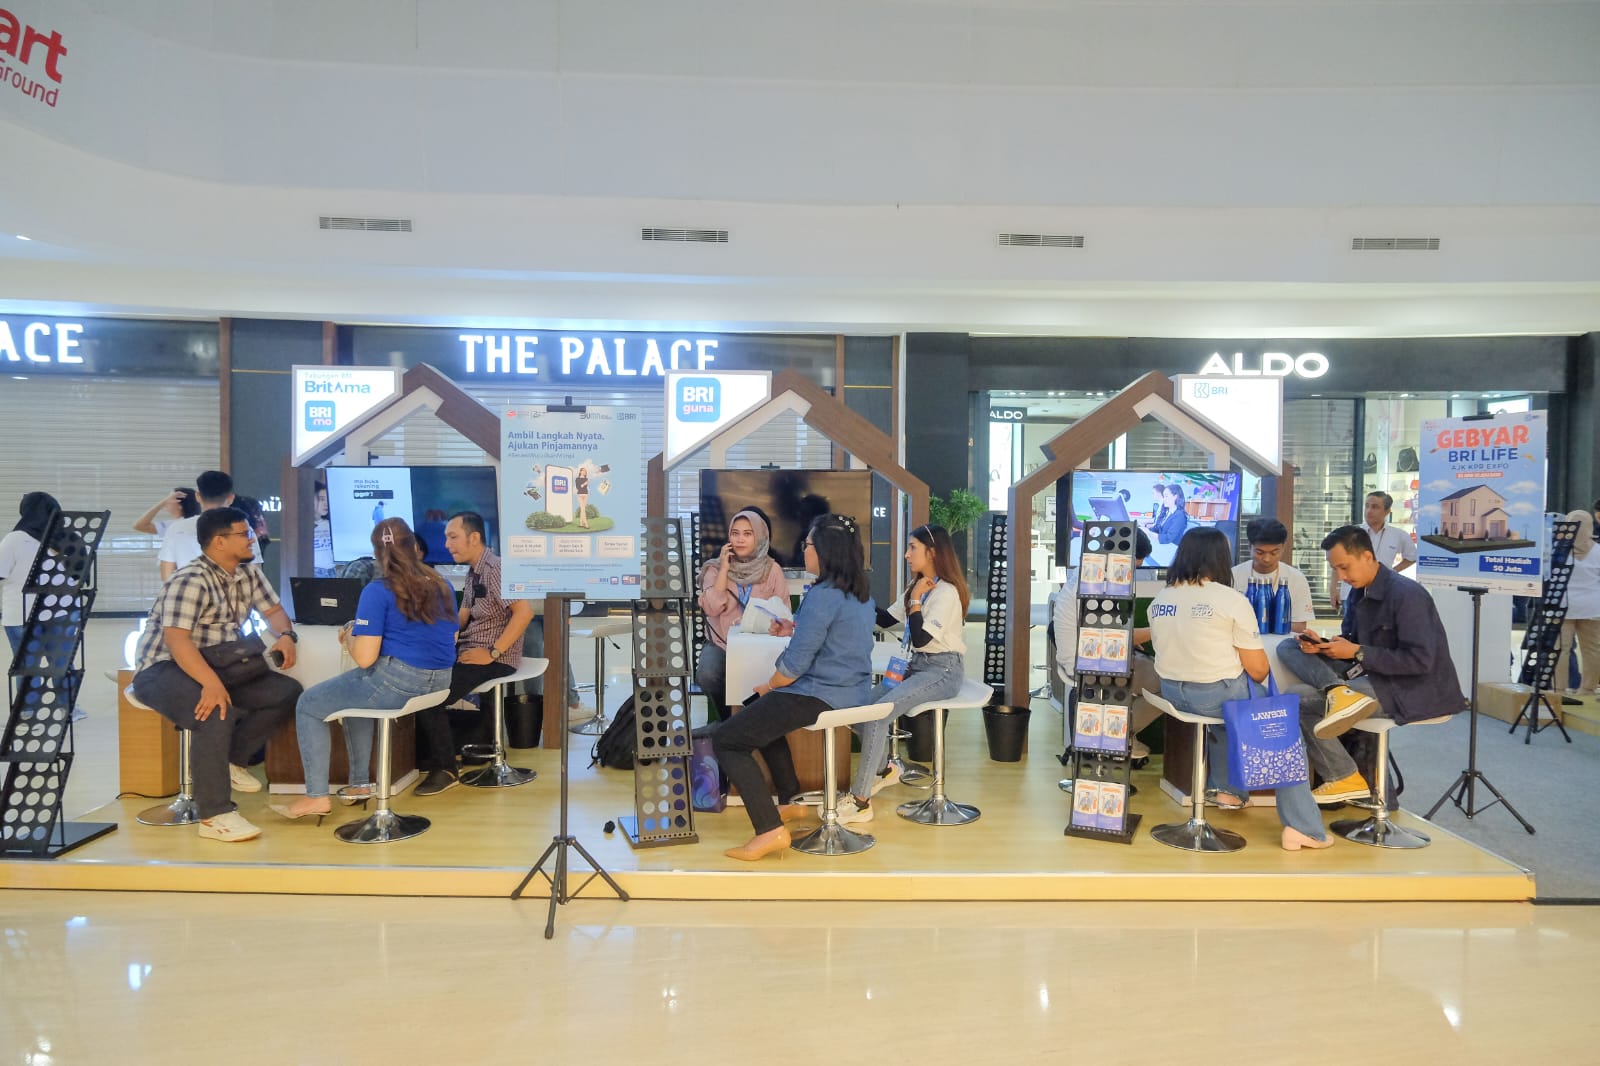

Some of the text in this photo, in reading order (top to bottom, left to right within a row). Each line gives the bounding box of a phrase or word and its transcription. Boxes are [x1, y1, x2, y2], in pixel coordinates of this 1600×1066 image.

[0, 320, 84, 363] ACE
[459, 334, 719, 376] THE PALACE
[1198, 351, 1330, 379] ALDO
[304, 380, 371, 394] BritAma
[1211, 386, 1228, 395] BRI
[682, 386, 714, 403] BRI
[309, 406, 332, 418] BRI
[682, 404, 714, 415] guna
[990, 410, 1023, 420] ALDO
[312, 418, 332, 426] mo
[507, 431, 534, 440] Ambil
[536, 431, 574, 441] Langkah
[1437, 424, 1530, 449] GEBYAR
[507, 441, 599, 451] Ajukan Pinjamannya
[1448, 447, 1518, 462] BRI LIFE
[873, 507, 887, 517] CE
[1505, 557, 1532, 565] Hadiah
[1158, 604, 1177, 616] BRI
[1251, 708, 1288, 721] LAWSON
